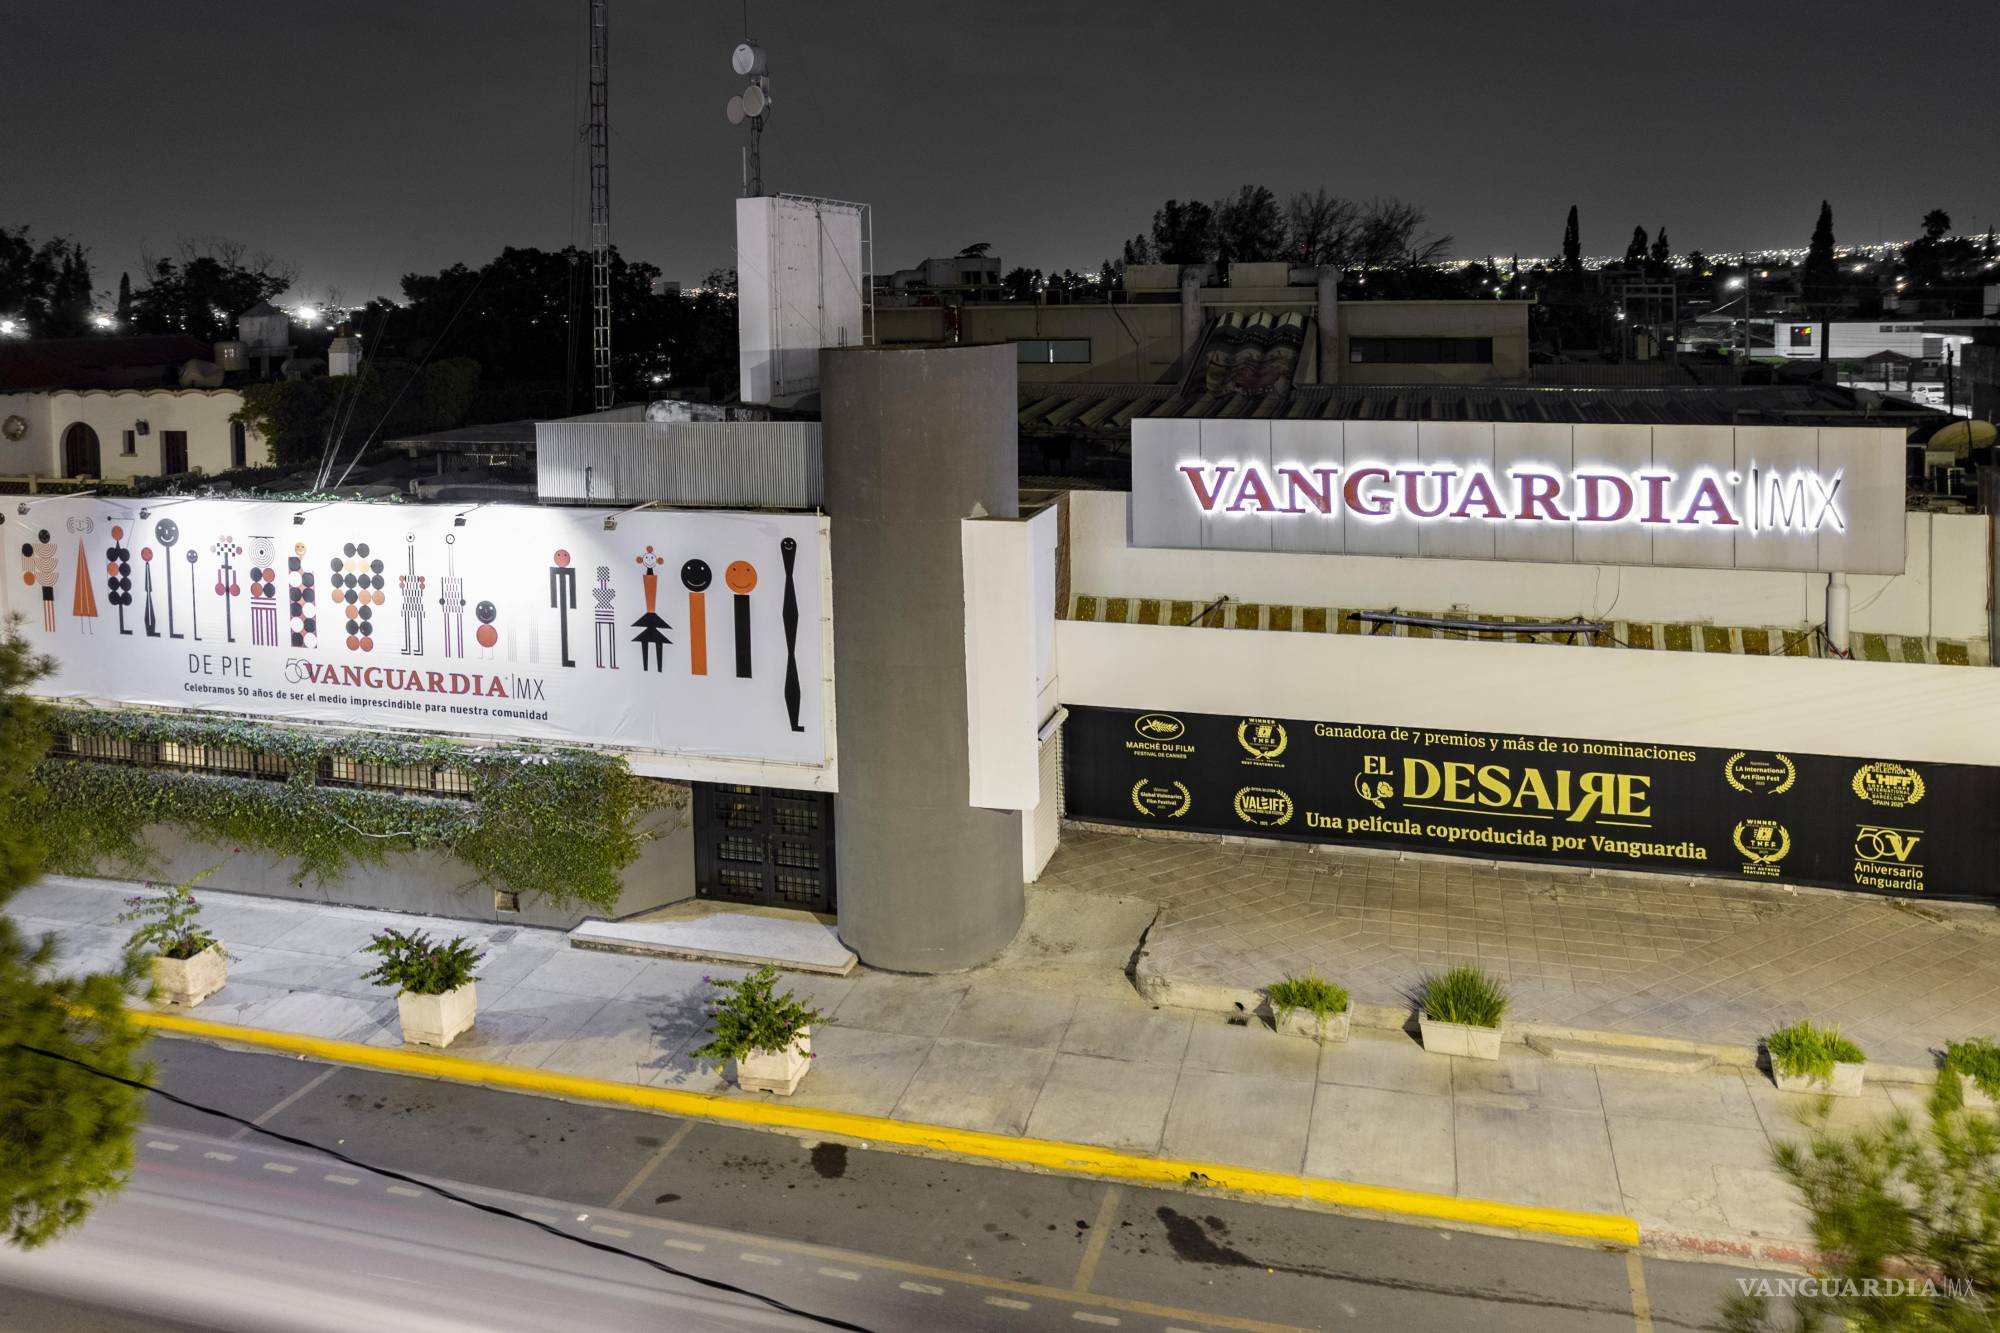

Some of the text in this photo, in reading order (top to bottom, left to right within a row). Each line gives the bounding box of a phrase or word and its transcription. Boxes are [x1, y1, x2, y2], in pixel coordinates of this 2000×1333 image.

[1179, 467, 1739, 525] VANGUARDIA
[189, 653, 252, 678] DE PIE
[303, 663, 509, 698] VANGUARDIA
[184, 682, 548, 721] Celebramos 50 años de ser el medio imprescindible para nuestra comunidad
[1162, 743, 1174, 751] DU
[1175, 744, 1195, 753] FILM
[1314, 723, 1697, 762] Ganadora de 7 premios y más de 10 nominaciones
[1363, 755, 1394, 776] EL
[1744, 766, 1786, 774] International
[1872, 766, 1906, 775] SELECTION
[1875, 762, 1902, 770] OFFICIAL
[1305, 811, 1708, 860] Una película coproducida por Vanguardia
[1854, 862, 1923, 879] Aniversario
[1854, 873, 1924, 890] Vanguardia
